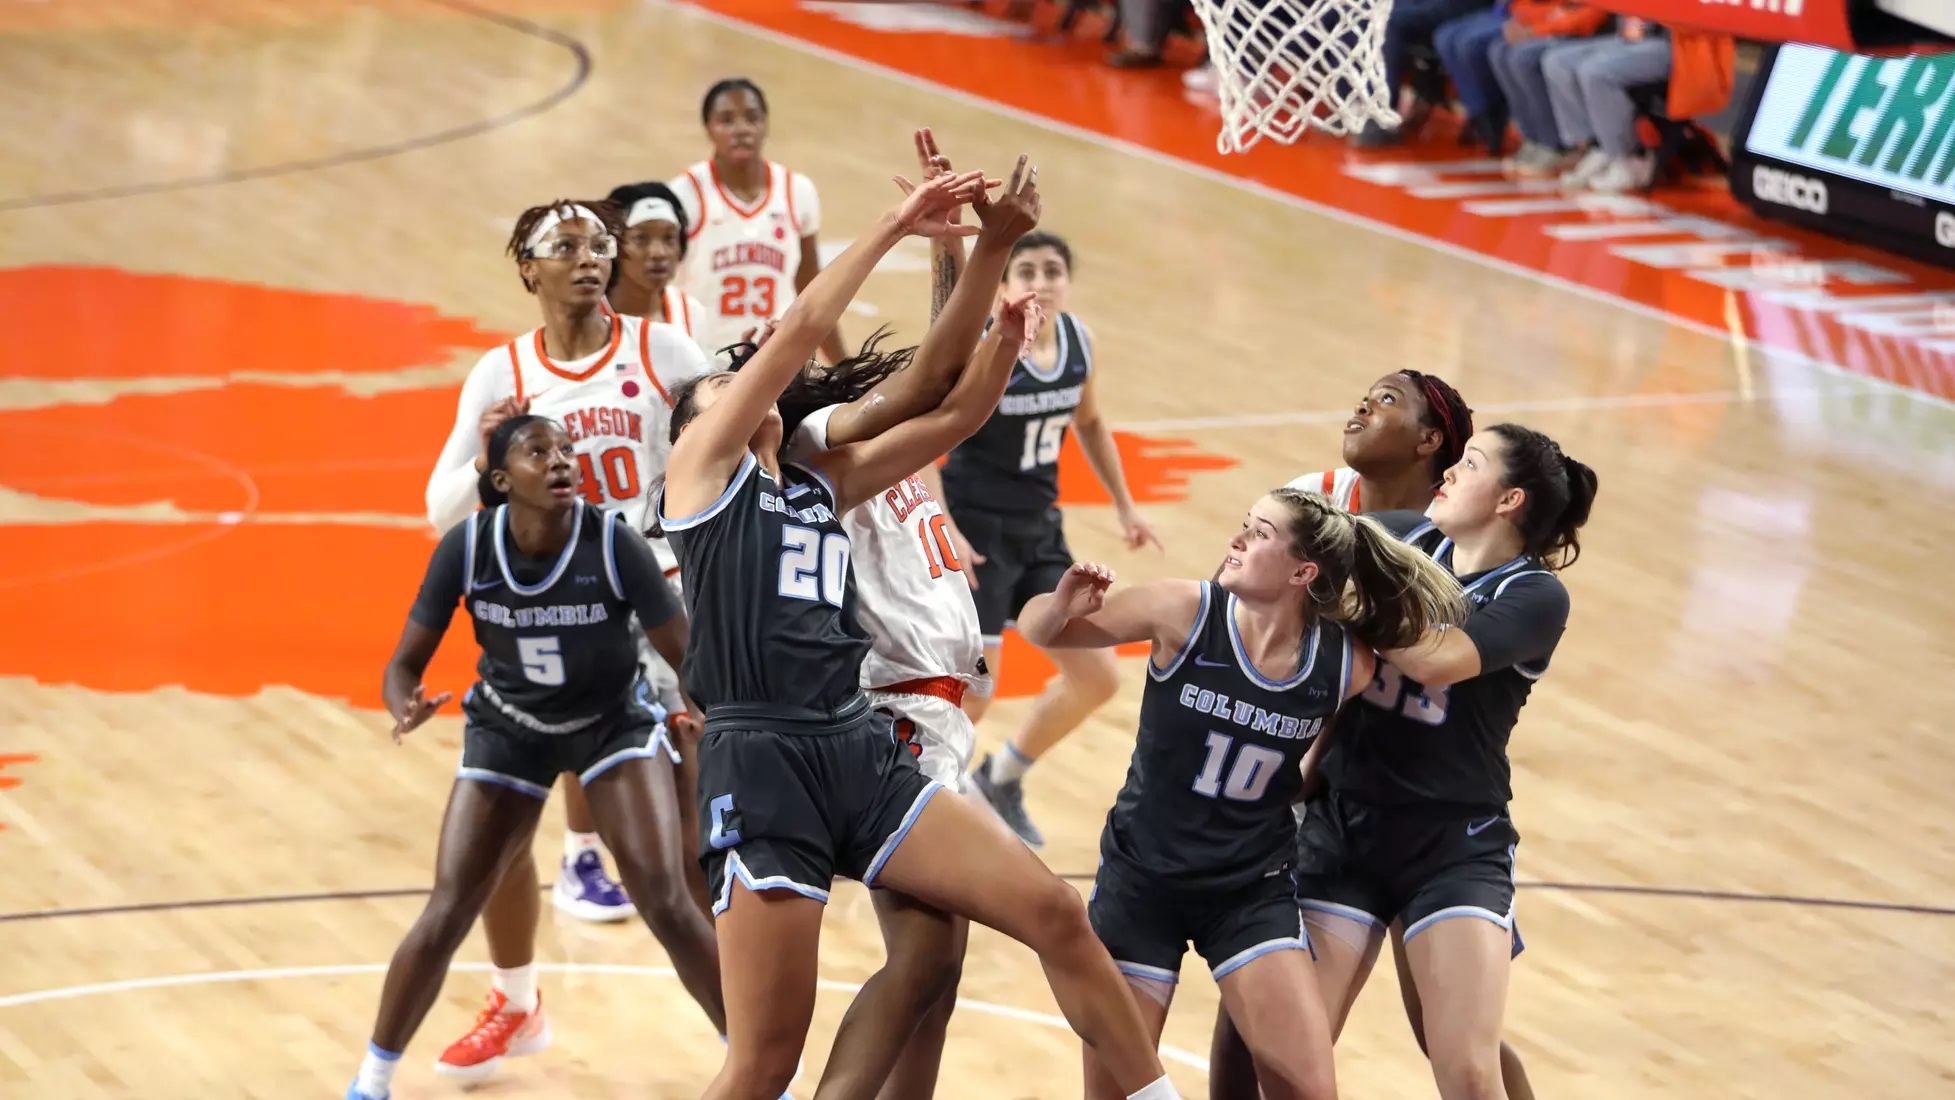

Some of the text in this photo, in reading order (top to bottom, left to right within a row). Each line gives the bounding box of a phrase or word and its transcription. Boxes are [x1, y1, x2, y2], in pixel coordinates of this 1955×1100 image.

[1753, 164, 1829, 215] GEICO
[712, 241, 785, 273] CLEMSON
[721, 275, 775, 317] 23
[564, 406, 642, 443] EMSON
[1020, 413, 1071, 471] 15
[576, 446, 640, 504] 40
[778, 523, 851, 609] 20
[918, 514, 963, 580] 10
[474, 600, 608, 628] COLUMBIA
[516, 636, 567, 686] 5
[1179, 683, 1323, 740] COLUMBIA
[1192, 730, 1285, 801] 10
[710, 793, 742, 849] C
